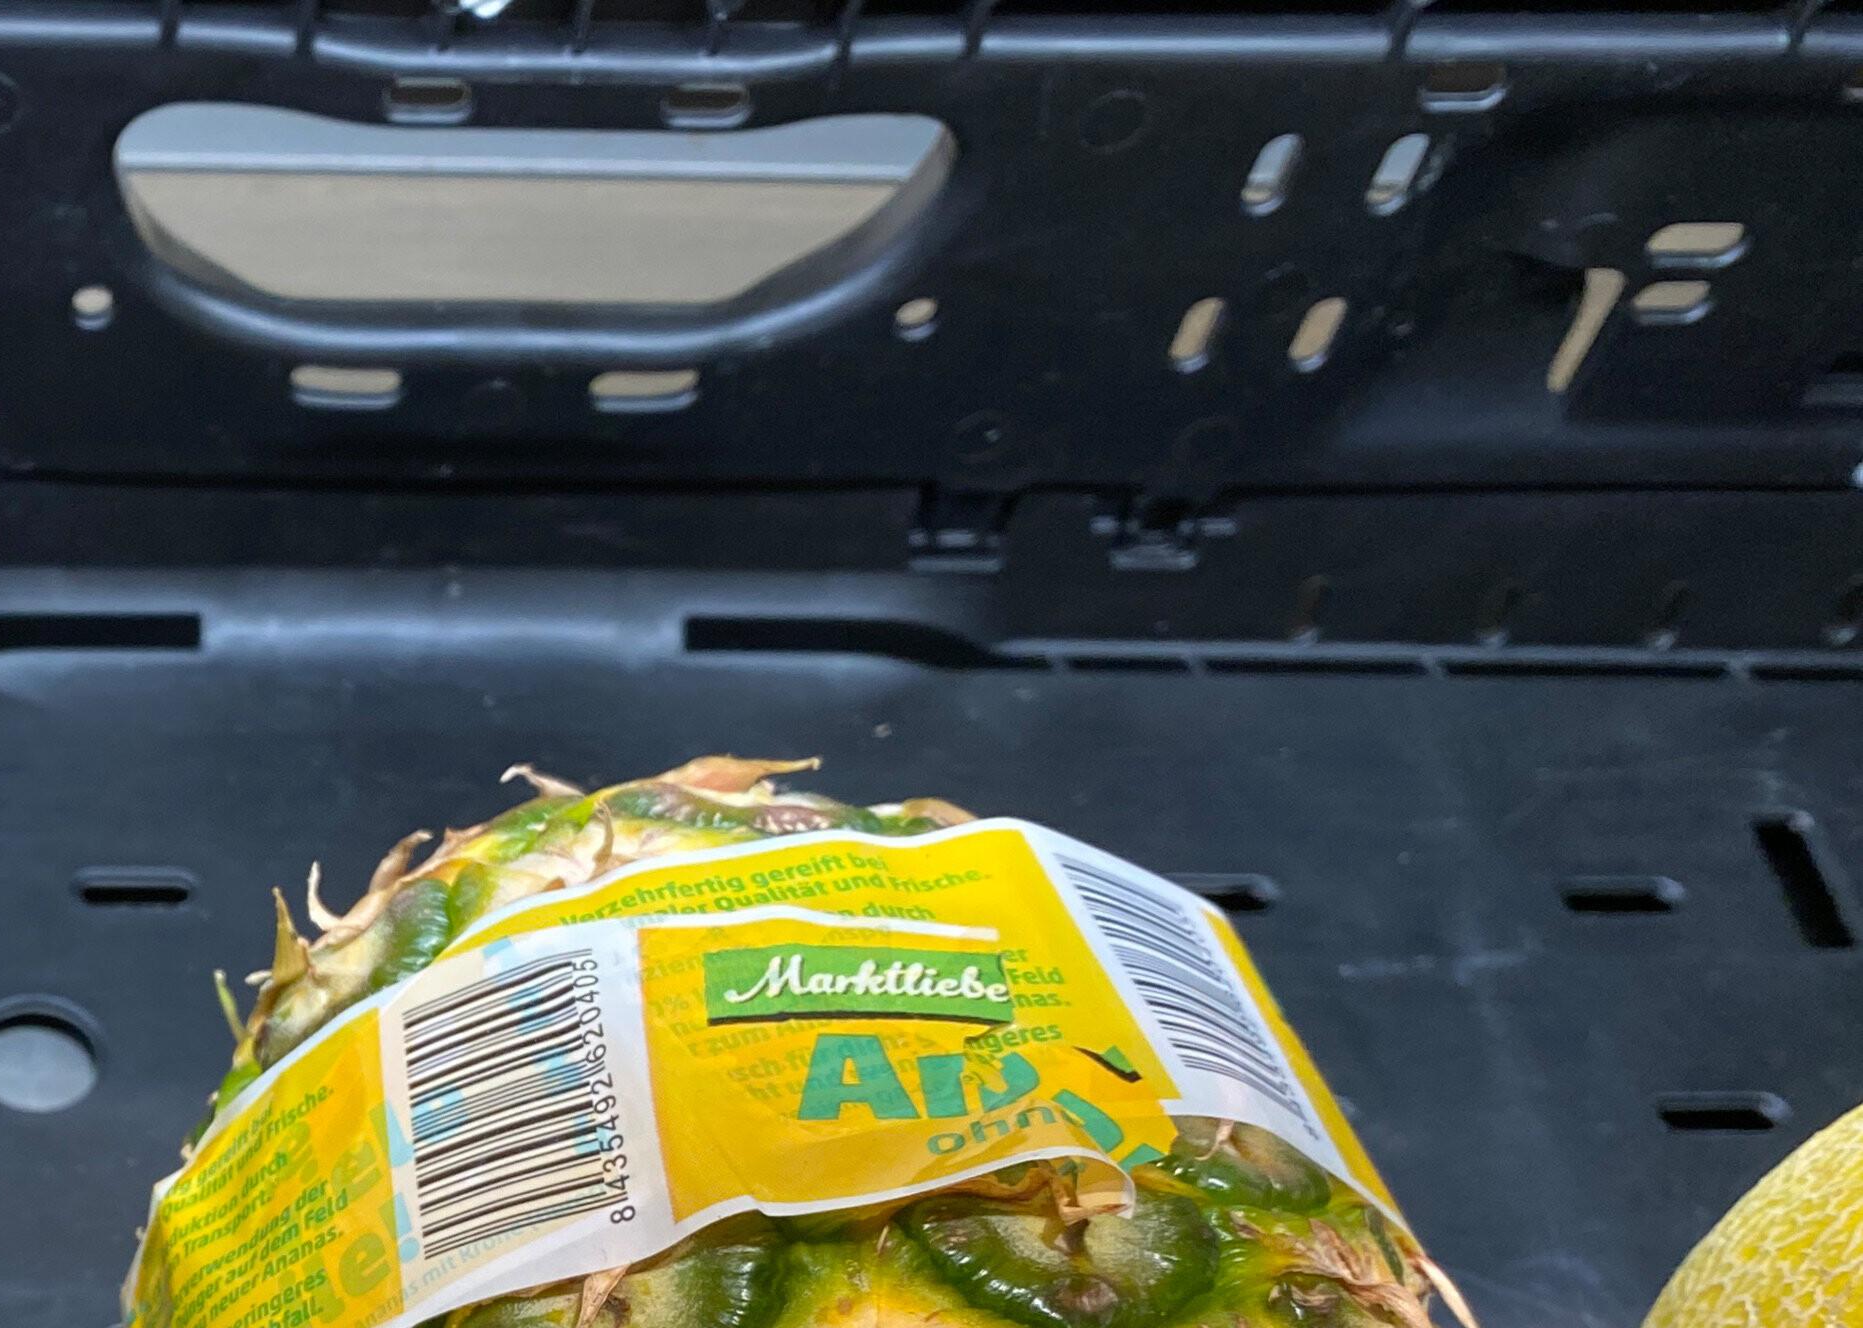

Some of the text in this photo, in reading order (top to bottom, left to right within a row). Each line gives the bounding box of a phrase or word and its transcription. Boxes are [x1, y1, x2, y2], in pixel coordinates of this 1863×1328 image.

[713, 879, 829, 911] Qualität
[832, 873, 887, 893] und
[750, 854, 846, 888] gereift
[847, 853, 888, 871] bei
[724, 954, 1011, 1004] Marktliebe
[1001, 947, 1028, 964] er
[1007, 966, 1065, 985] Feld
[237, 1132, 263, 1171] und
[265, 1085, 334, 1141] Frische.
[241, 1151, 288, 1198] durch
[295, 1177, 329, 1211] der
[183, 1190, 273, 1257] Transport.
[225, 1251, 258, 1286] auf
[259, 1222, 300, 1263] dem
[303, 1187, 349, 1231] Feld
[261, 1225, 345, 1281] Ananas.
